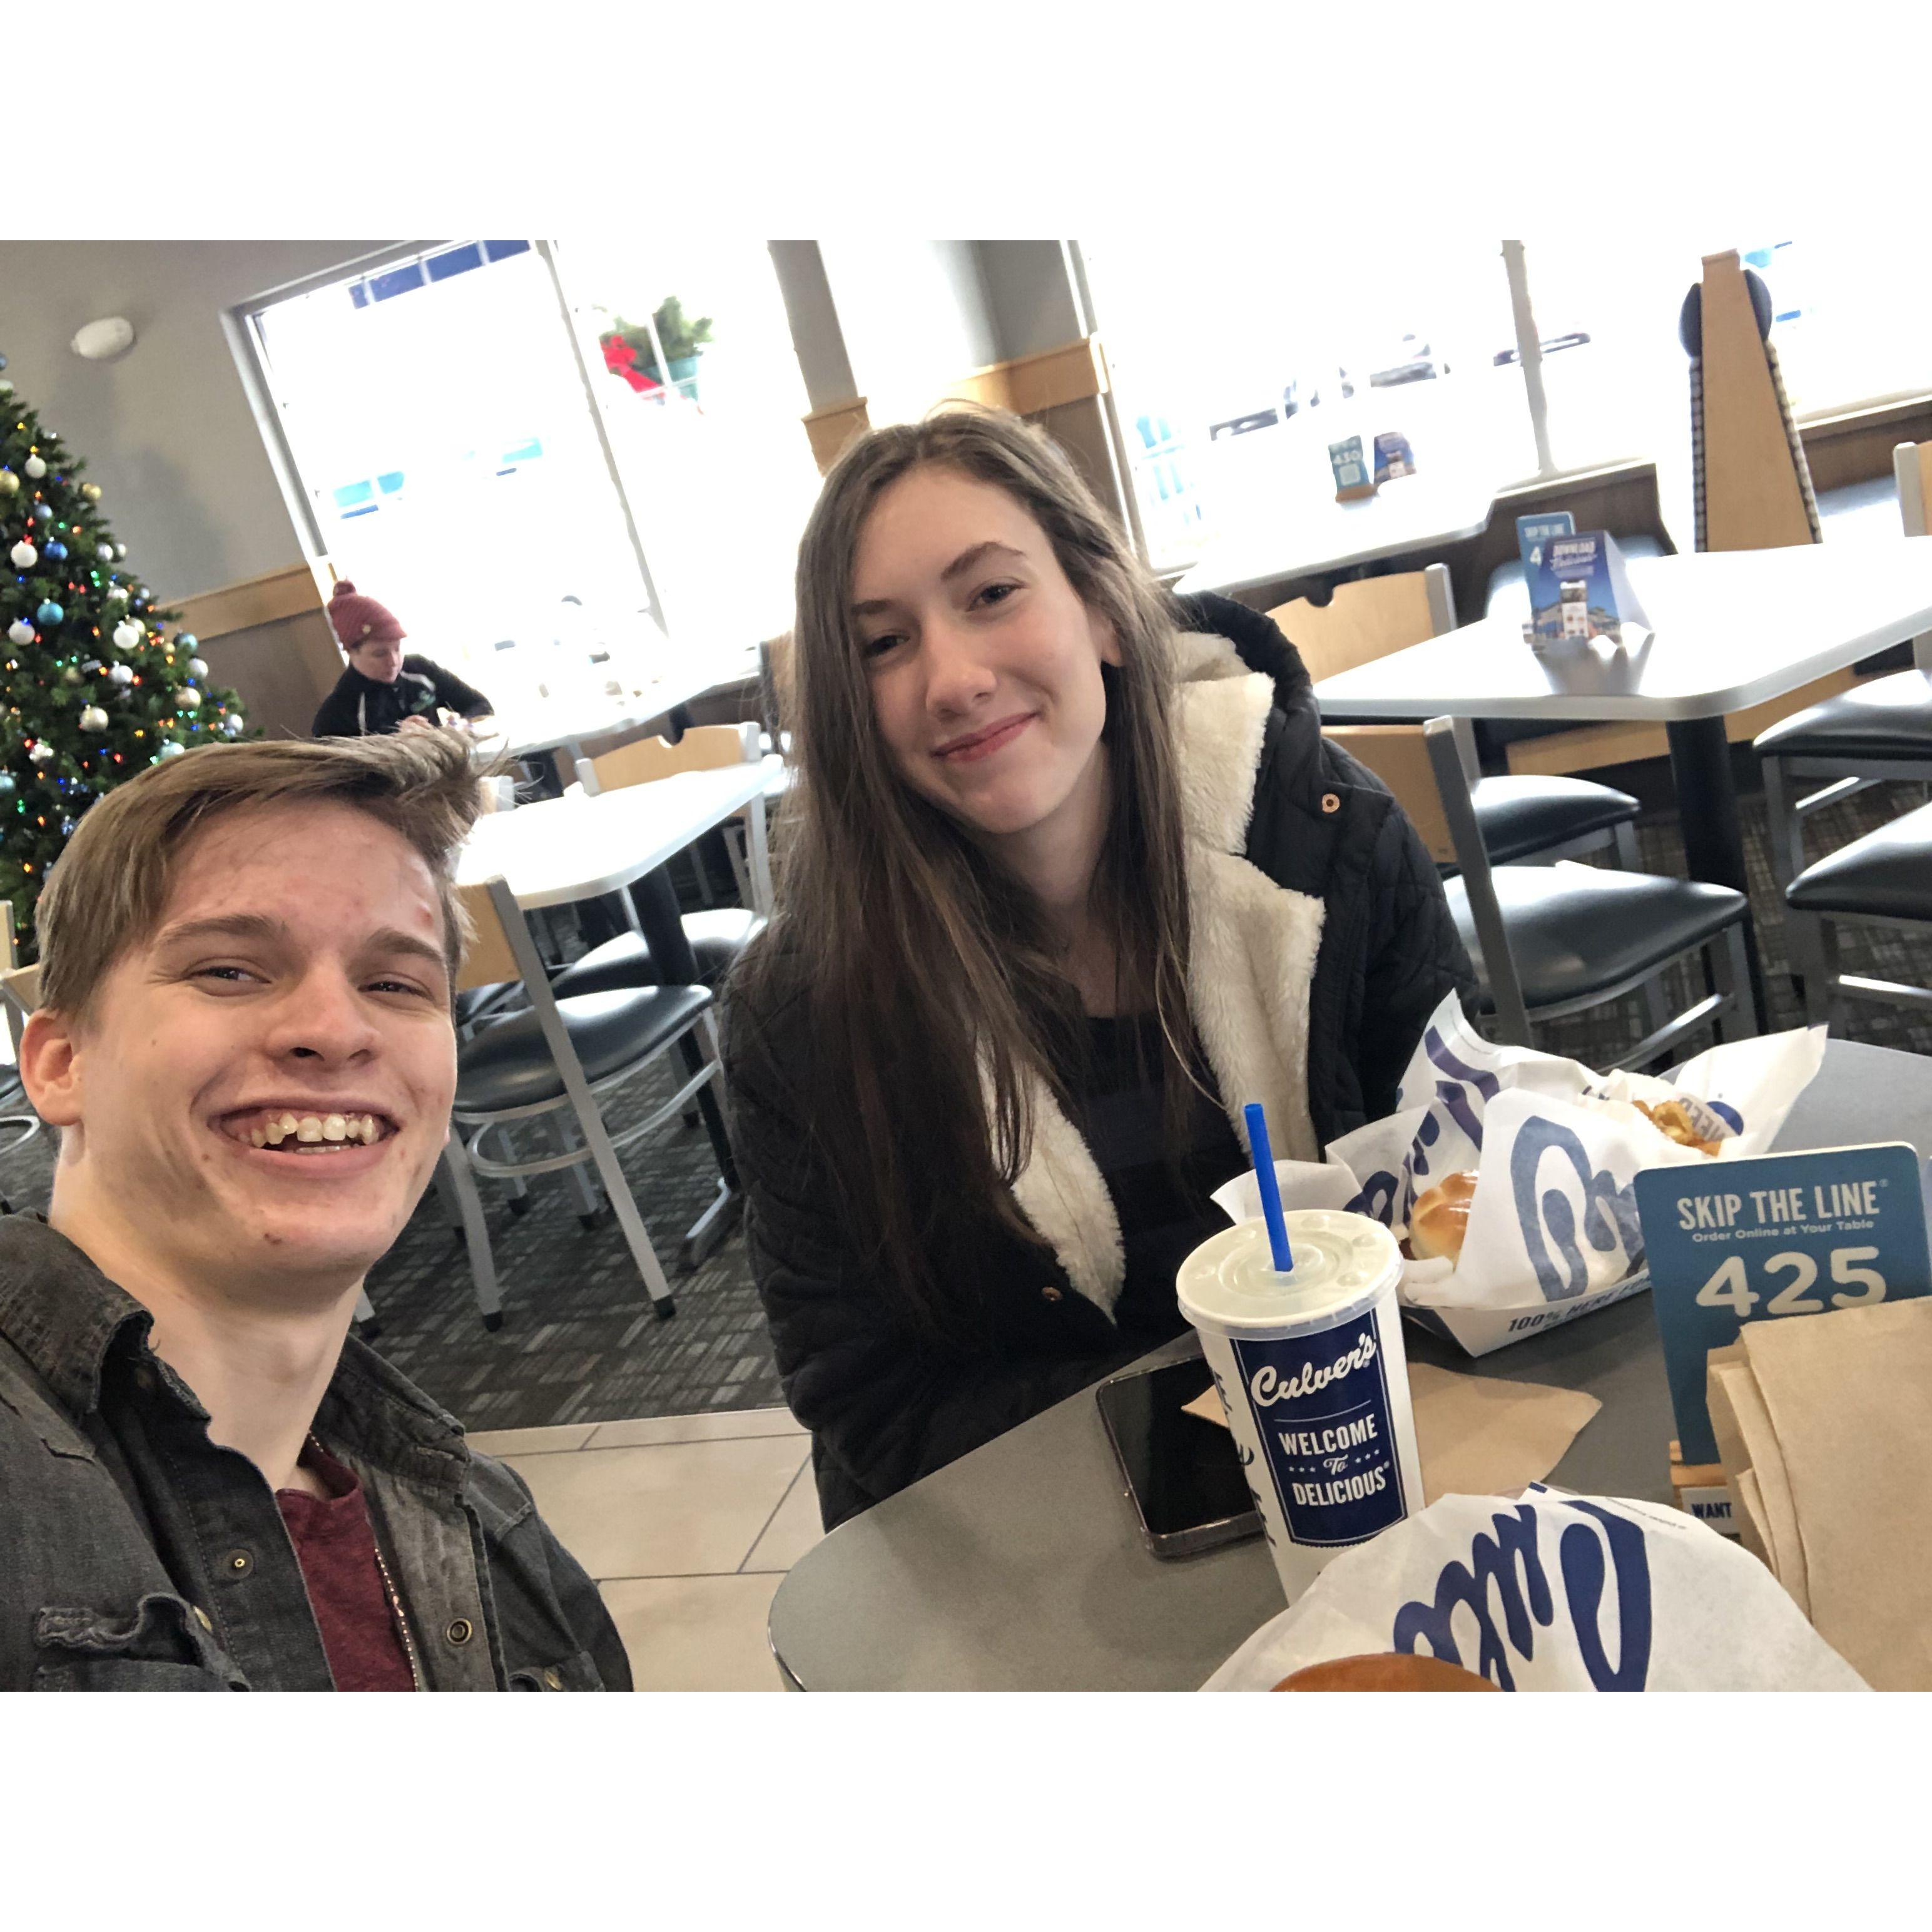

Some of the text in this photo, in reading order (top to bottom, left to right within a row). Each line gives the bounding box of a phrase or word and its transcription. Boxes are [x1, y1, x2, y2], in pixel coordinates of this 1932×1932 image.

[1677, 1194, 1742, 1231] SKIP
[1750, 1188, 1807, 1224] THE
[1692, 1219, 1874, 1243] Order Online at Your Table
[1695, 1246, 1886, 1318] 425
[1508, 1310, 1560, 1332] 100%
[1251, 1333, 1377, 1407] Culver's
[1278, 1413, 1378, 1456] WELCOME
[1323, 1454, 1349, 1475] To
[1291, 1466, 1386, 1507] DELICIOUS
[1690, 1502, 1732, 1519] WANT
